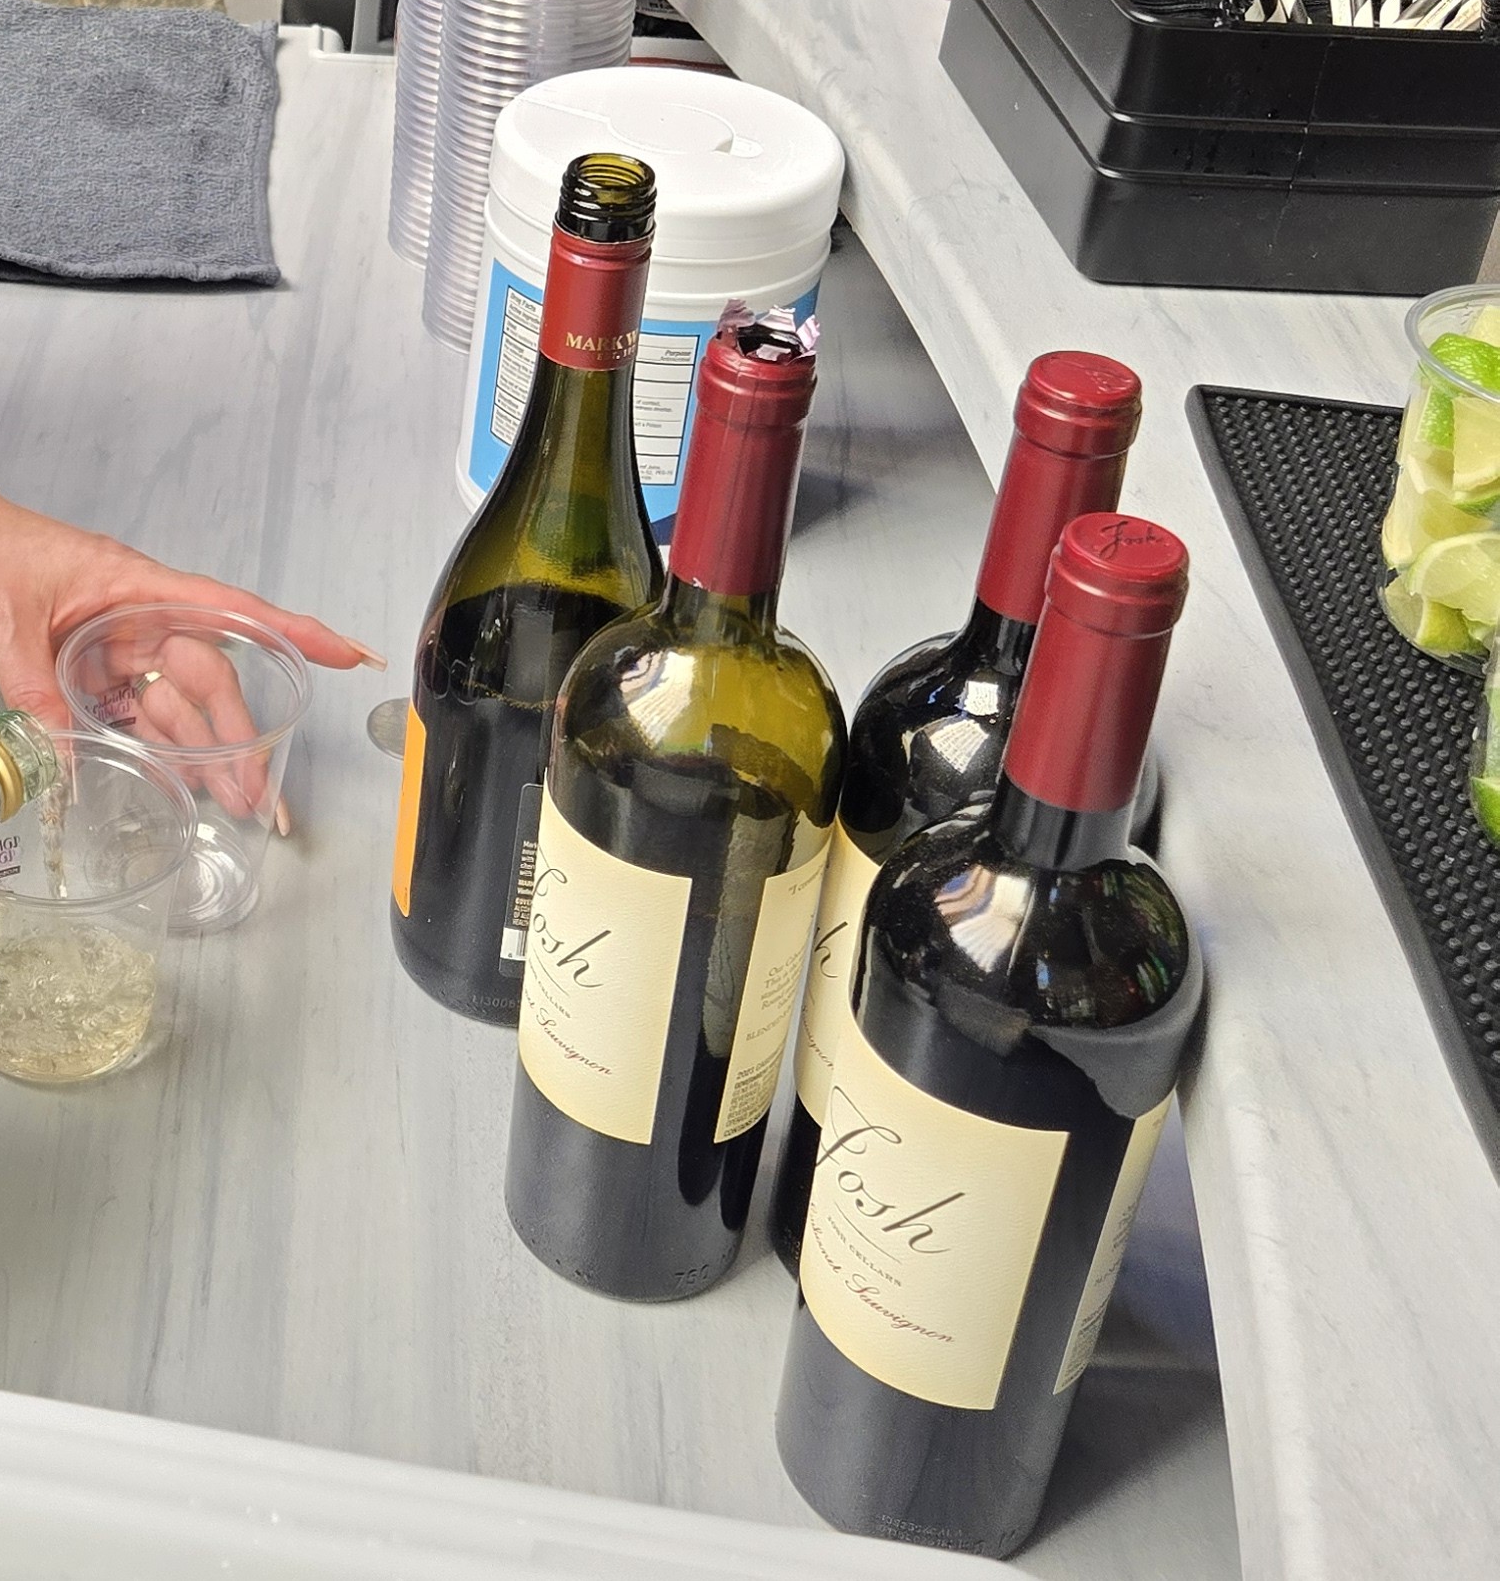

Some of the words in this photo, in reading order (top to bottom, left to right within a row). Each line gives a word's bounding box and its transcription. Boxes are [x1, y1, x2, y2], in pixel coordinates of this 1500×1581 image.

[566, 331, 623, 351] MARK
[536, 1007, 612, 1076] Sauvignon
[815, 1085, 966, 1254] Josh
[849, 1244, 902, 1287] CELLARS
[845, 1273, 955, 1343] Sauvignon
